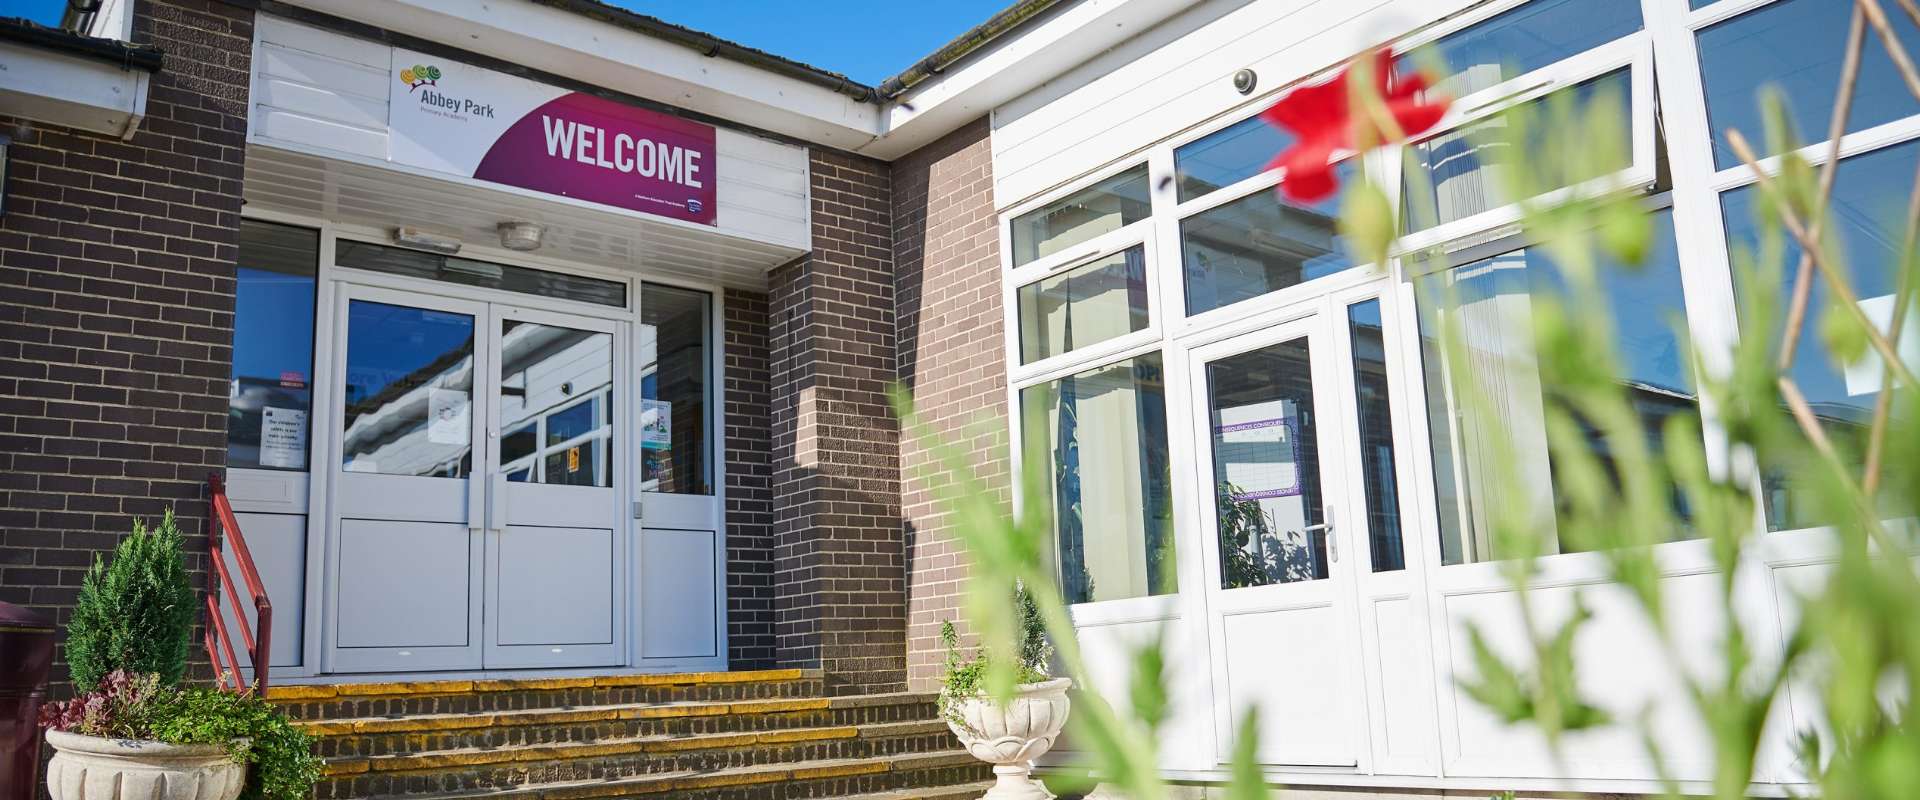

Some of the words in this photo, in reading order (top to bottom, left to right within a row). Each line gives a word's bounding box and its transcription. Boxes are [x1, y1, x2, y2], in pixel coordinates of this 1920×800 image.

[421, 89, 461, 113] Abbey
[464, 99, 494, 119] Park
[542, 114, 703, 189] WELCOME
